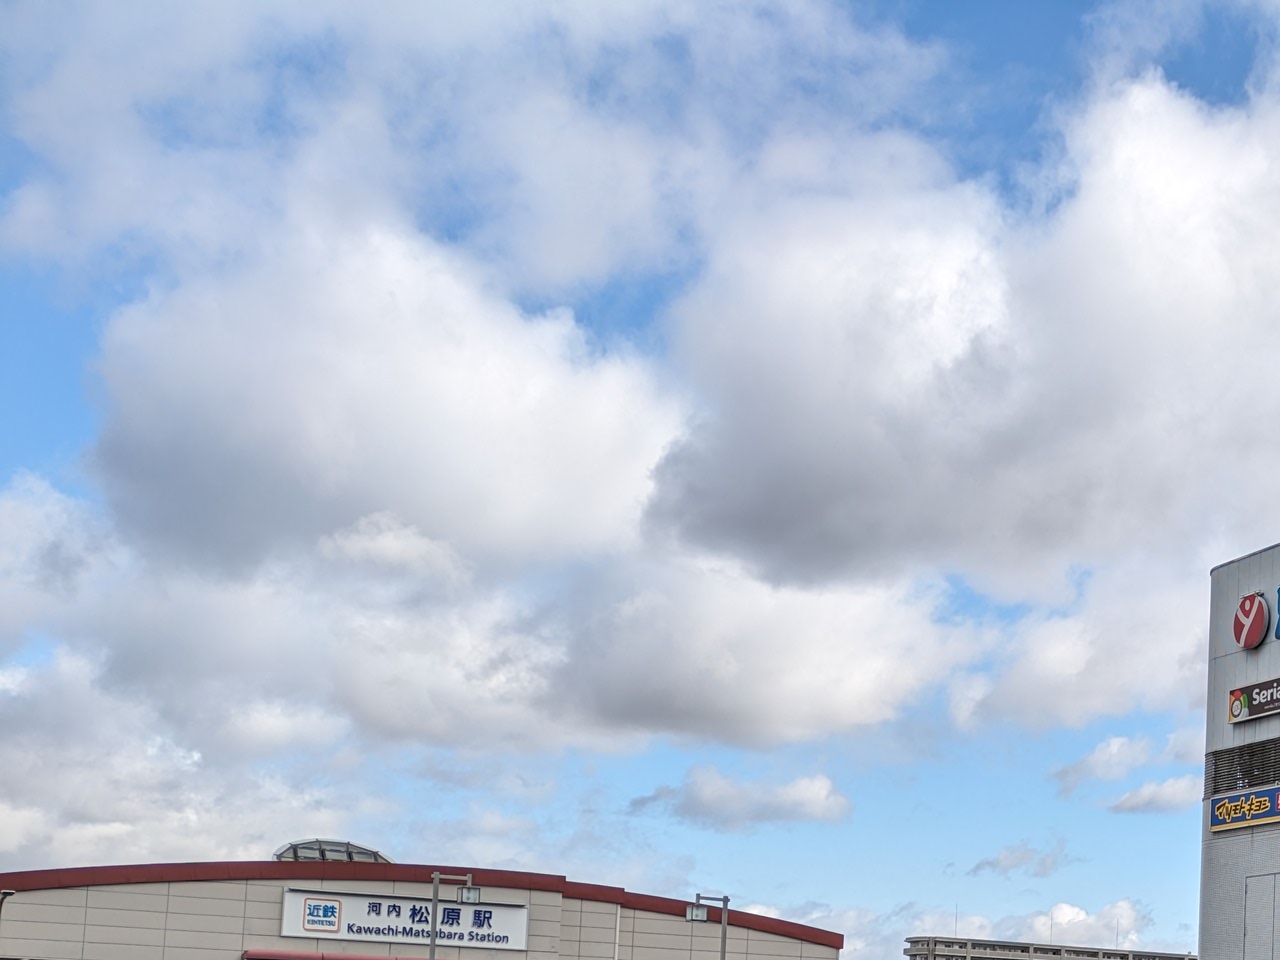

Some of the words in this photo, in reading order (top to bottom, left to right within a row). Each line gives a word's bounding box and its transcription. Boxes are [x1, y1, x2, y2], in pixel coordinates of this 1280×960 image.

[1216, 795, 1271, 822] マツモトキヨシ
[307, 904, 337, 918] 近鉄
[367, 902, 493, 929] 河内松原駅
[307, 919, 336, 927] KINTETSU
[468, 930, 509, 943] Station
